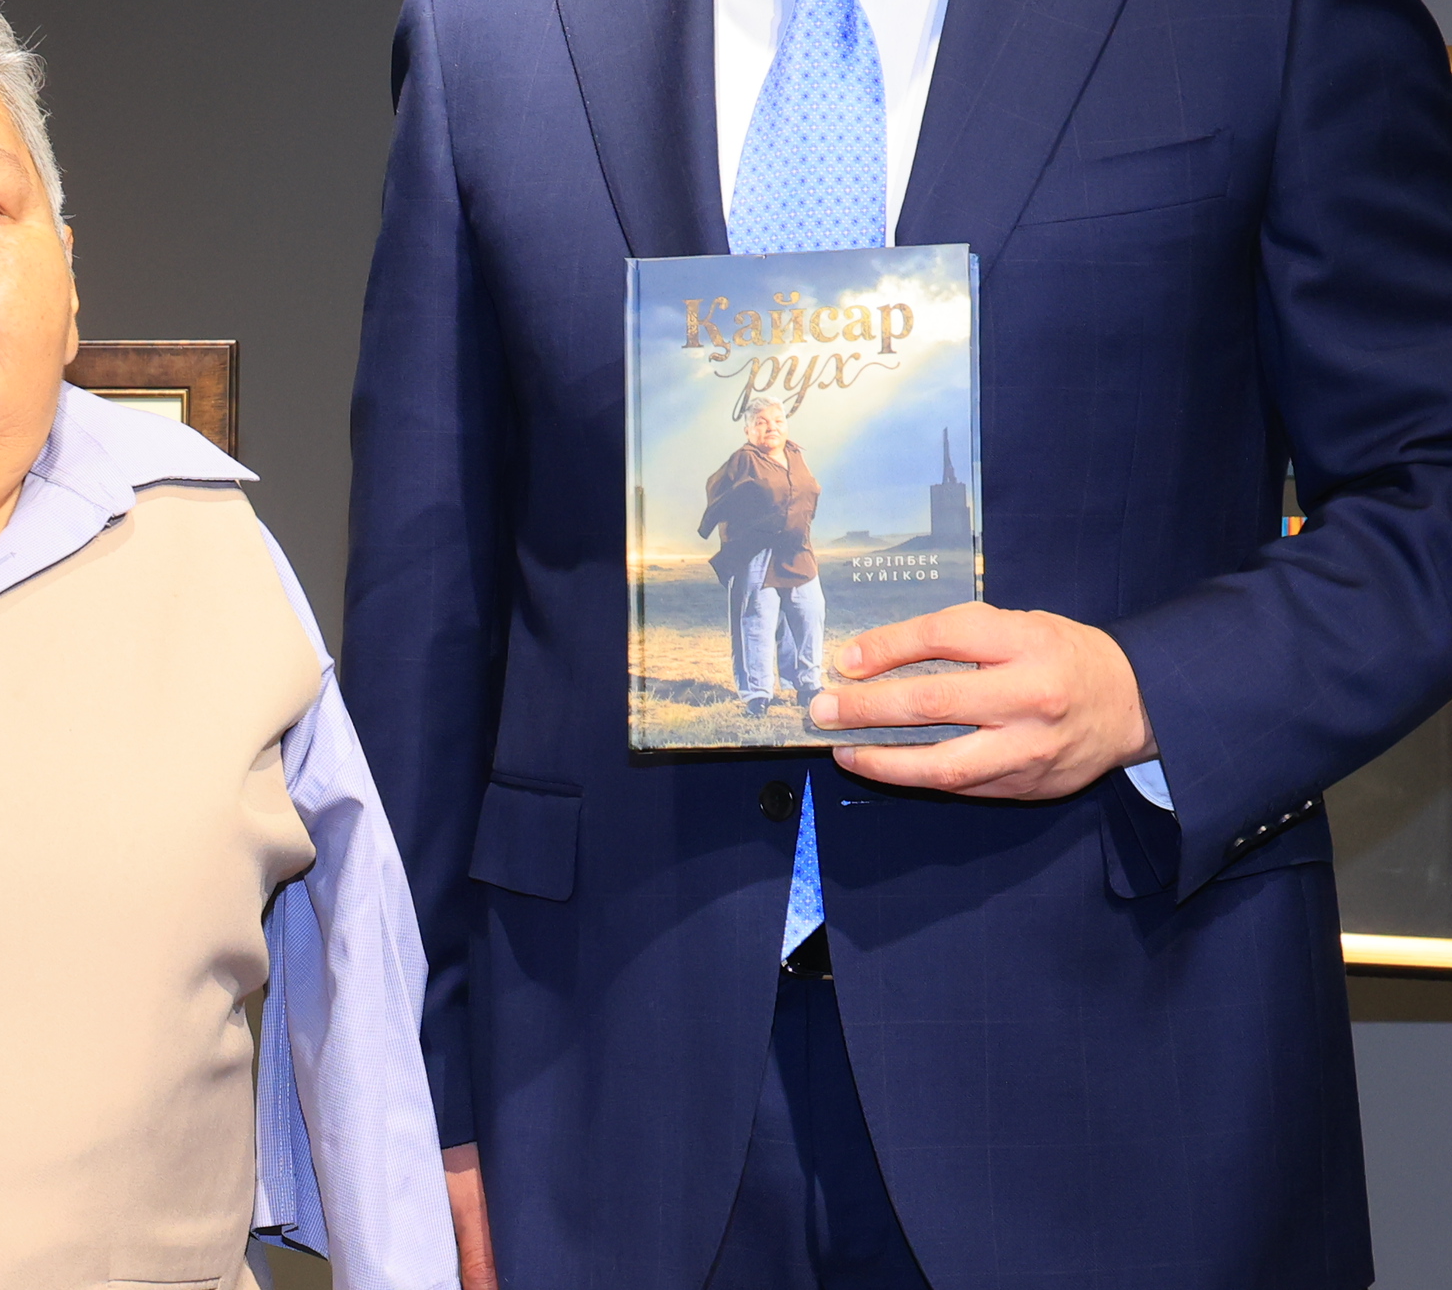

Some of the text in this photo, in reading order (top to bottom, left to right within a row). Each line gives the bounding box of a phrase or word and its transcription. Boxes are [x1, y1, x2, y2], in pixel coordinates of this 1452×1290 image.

[681, 291, 915, 362] Қайсар
[714, 350, 901, 421] рух
[851, 553, 940, 568] КӘРІПБЕК
[852, 568, 940, 582] КҮЙІКОВ
